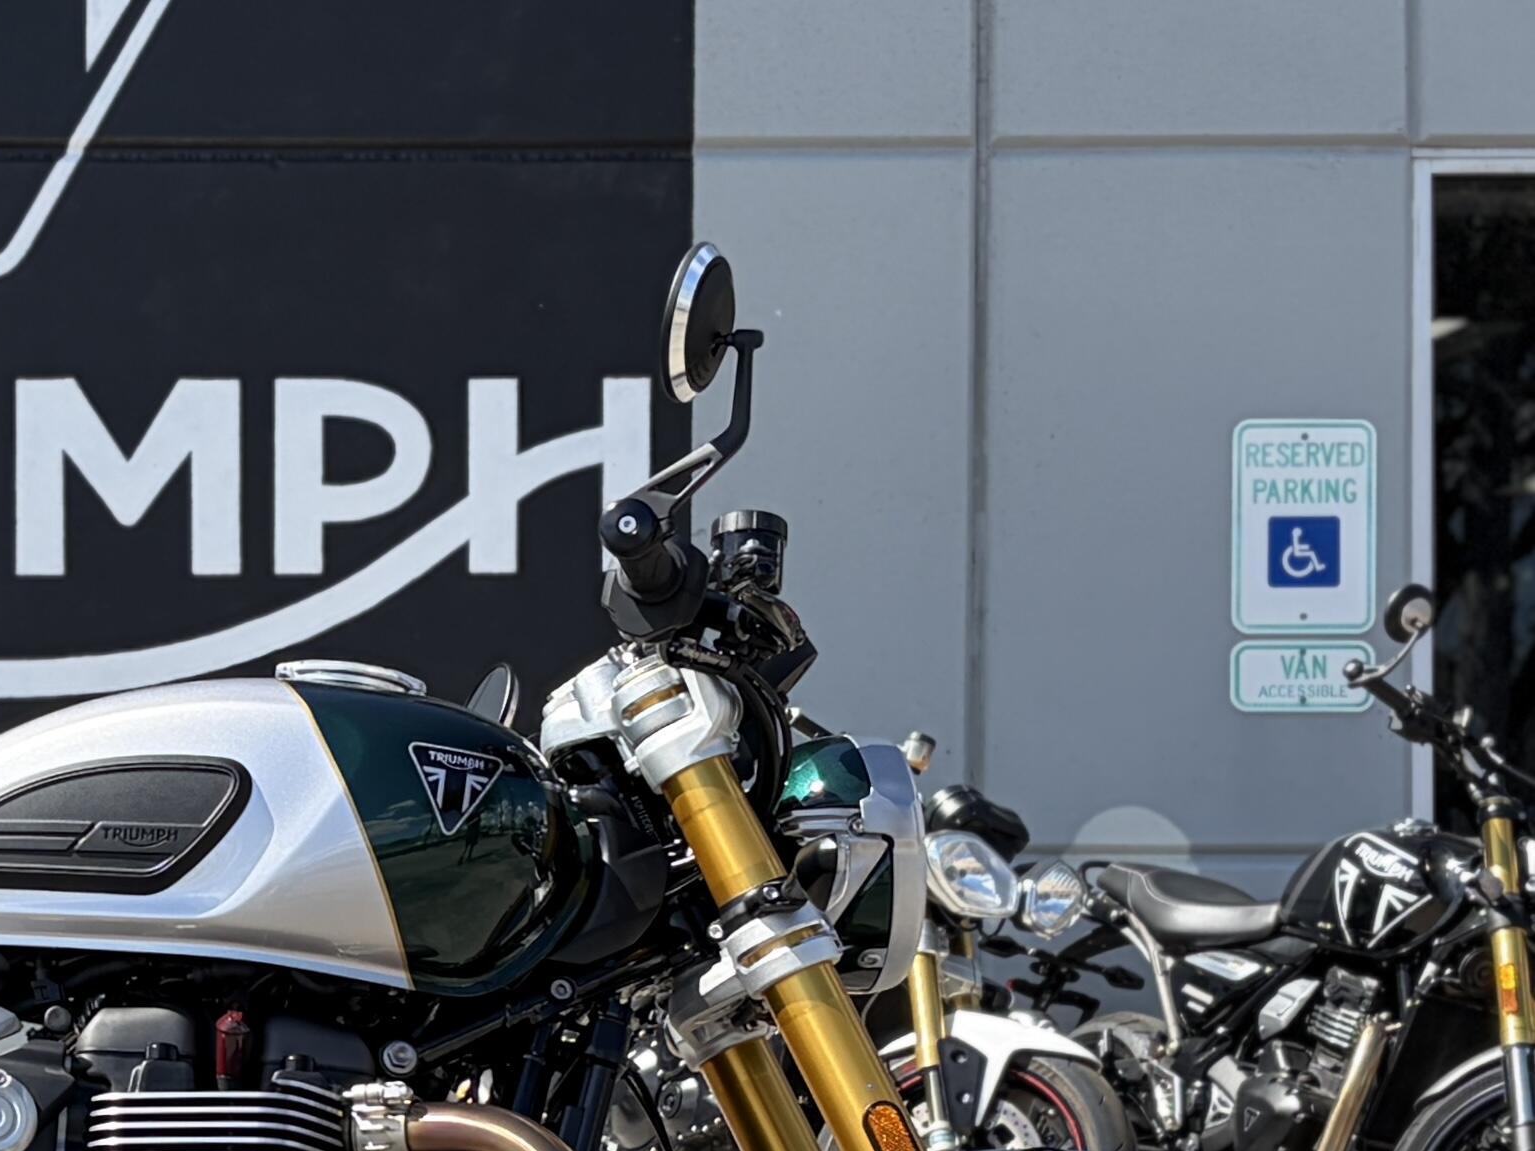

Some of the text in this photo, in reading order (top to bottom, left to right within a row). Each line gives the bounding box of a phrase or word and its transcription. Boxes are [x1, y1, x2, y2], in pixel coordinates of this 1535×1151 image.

[1245, 442, 1365, 468] RESERVED
[1252, 478, 1358, 504] PARKING
[1280, 655, 1327, 679] VAN
[1257, 684, 1348, 699] ACCESSIBLE
[427, 750, 485, 770] TRIUMPH
[102, 827, 179, 848] TRIUMPH
